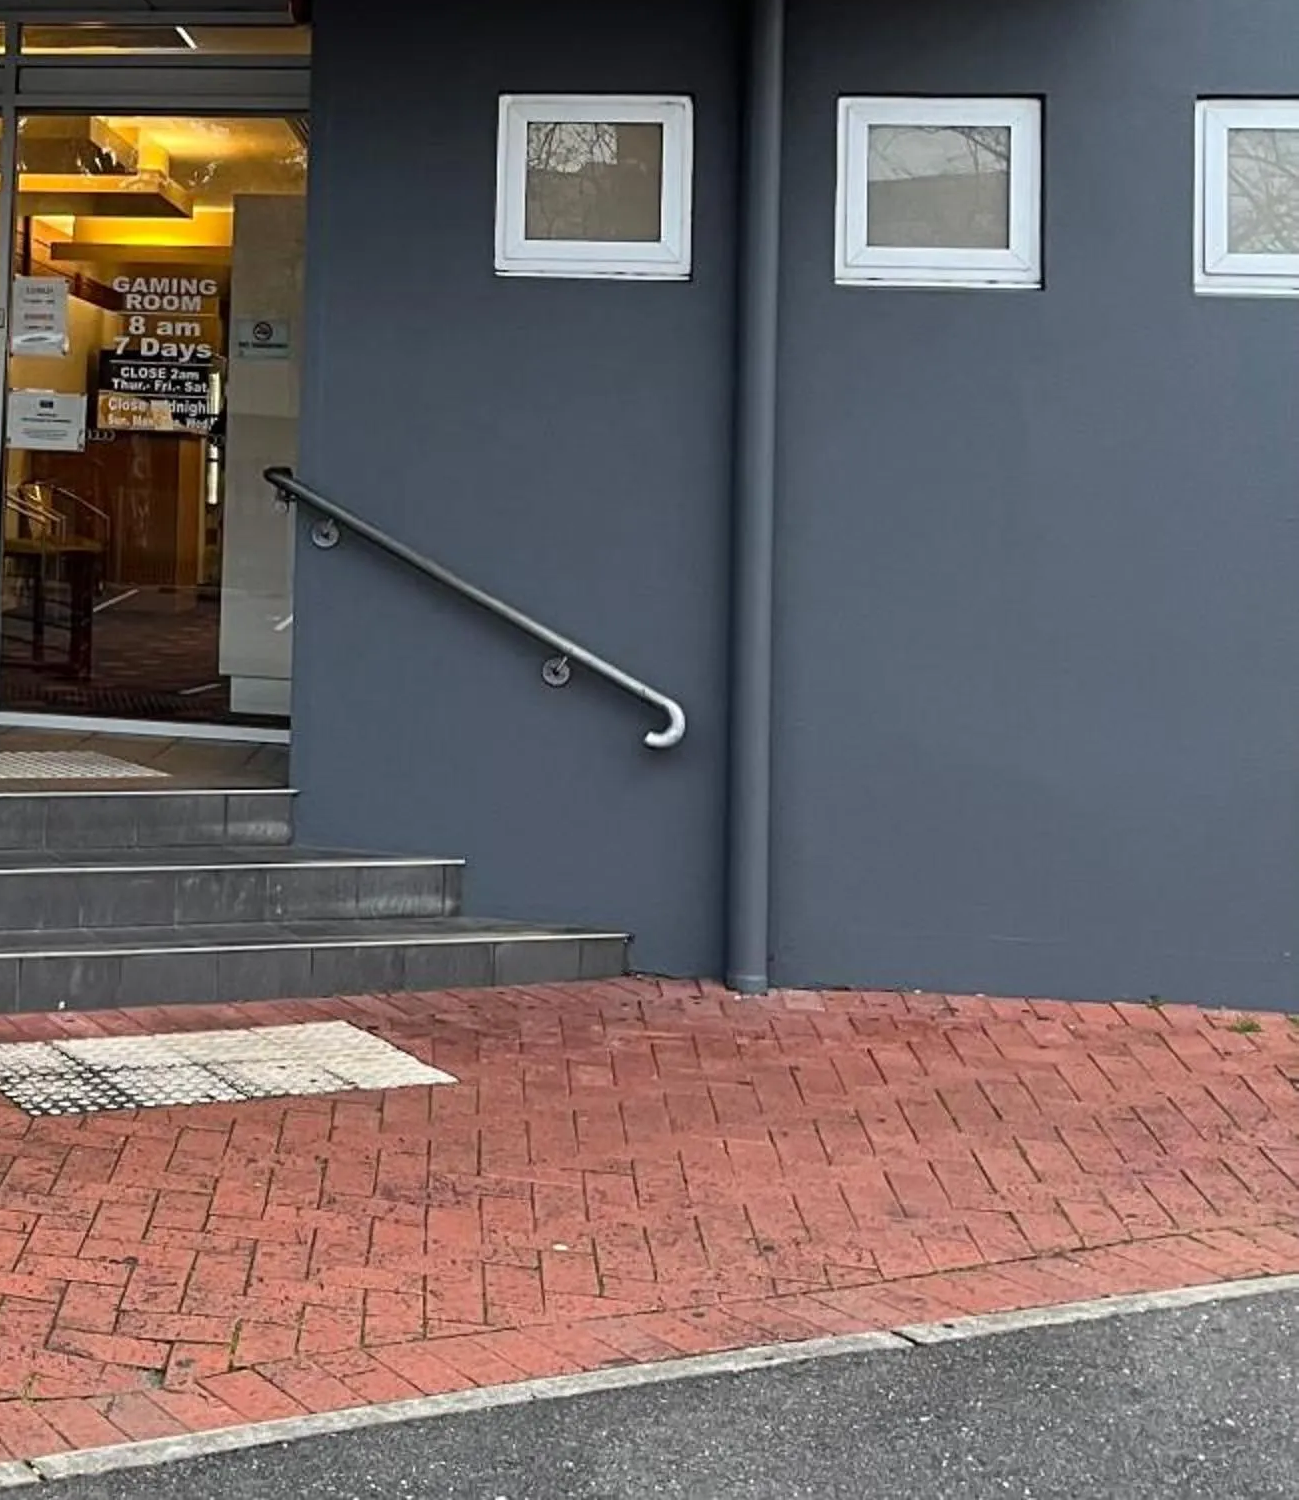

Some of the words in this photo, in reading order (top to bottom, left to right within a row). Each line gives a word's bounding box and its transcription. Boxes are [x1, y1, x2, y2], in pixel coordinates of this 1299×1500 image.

[112, 276, 218, 296] GAMING
[126, 293, 202, 312] ROOM
[128, 315, 146, 335] 8
[156, 321, 201, 337] am
[113, 336, 130, 355] 7
[140, 337, 213, 363] Days
[120, 366, 167, 380] CLOSE
[170, 368, 200, 381] 2am
[151, 399, 211, 418] dnigh
